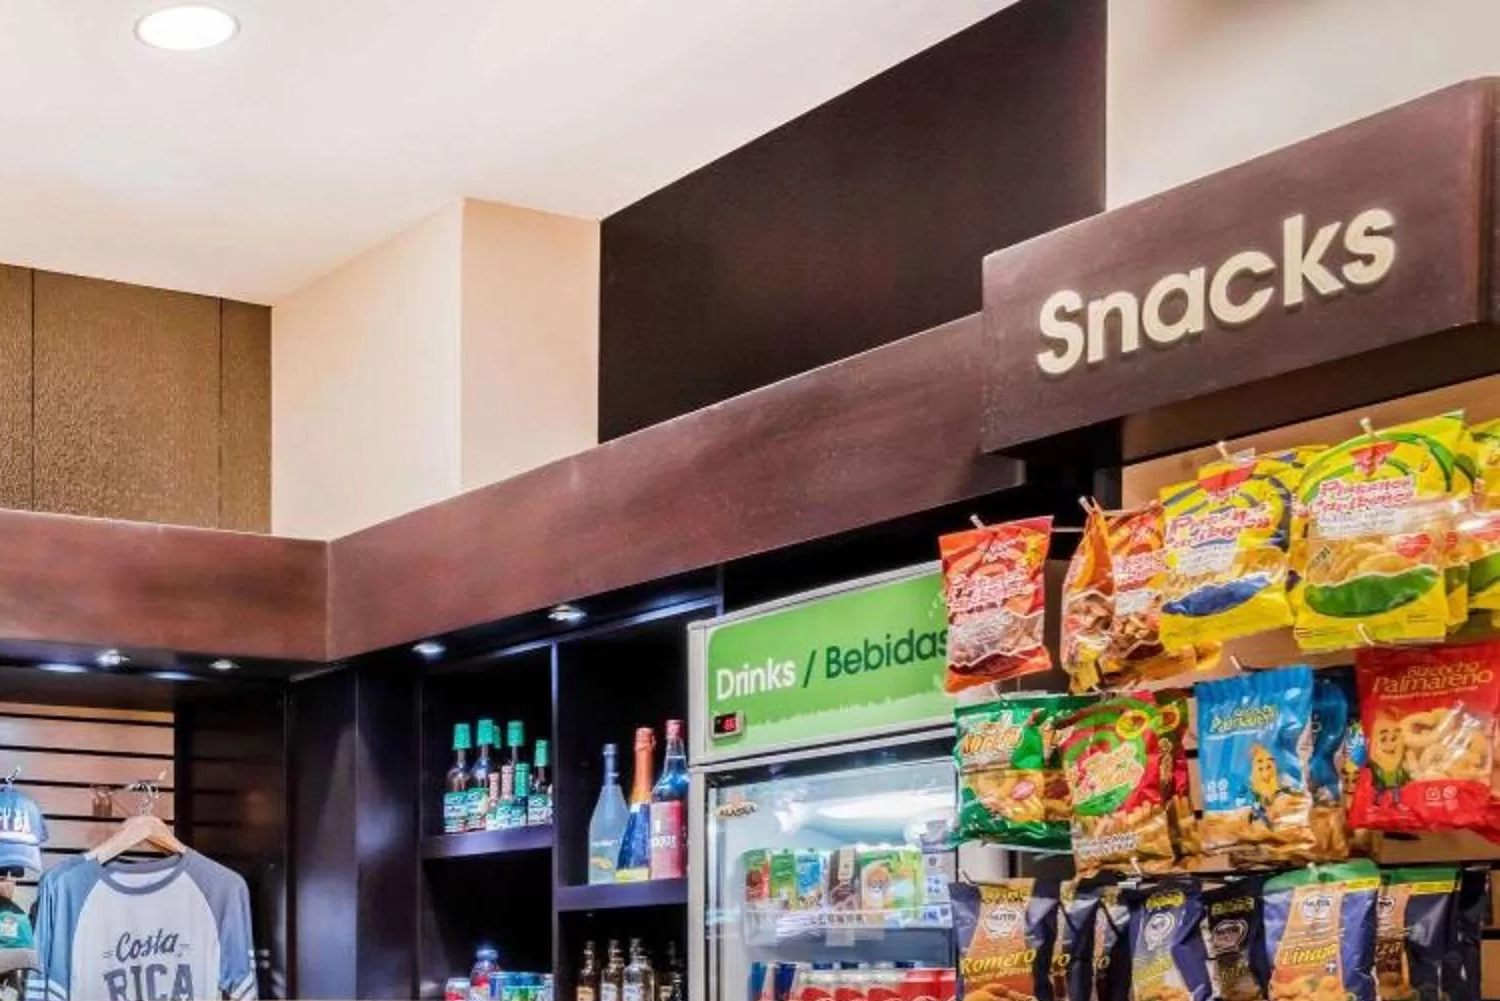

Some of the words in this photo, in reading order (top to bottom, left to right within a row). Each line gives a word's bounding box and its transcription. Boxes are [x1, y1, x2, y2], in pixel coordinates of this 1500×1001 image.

[1037, 206, 1397, 375] Snacks
[716, 657, 797, 701] Drinks
[115, 927, 180, 963] Costa
[961, 949, 1037, 977] Romero
